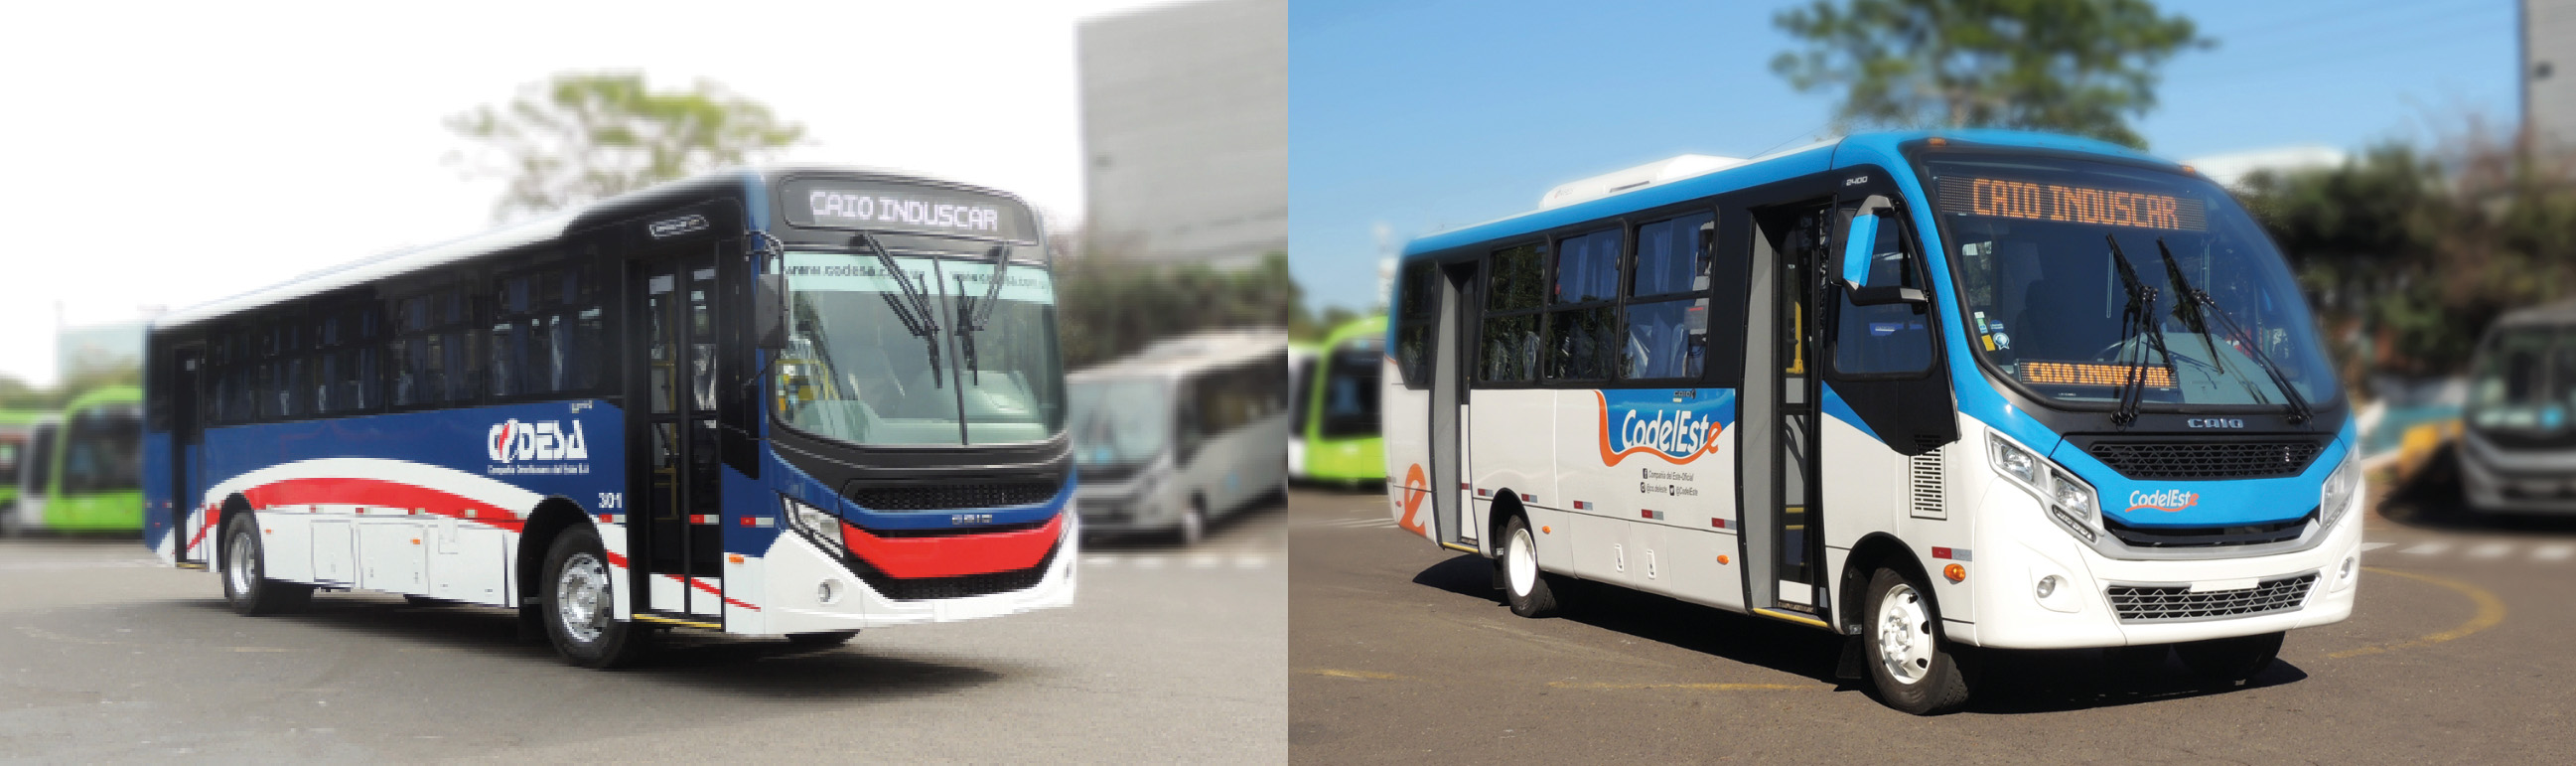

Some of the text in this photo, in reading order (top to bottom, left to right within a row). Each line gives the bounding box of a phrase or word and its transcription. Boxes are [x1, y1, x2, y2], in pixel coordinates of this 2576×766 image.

[810, 191, 998, 231] CAIO INDUSCAR
[1973, 178, 2179, 230] CAIO INDUSCAR
[2028, 362, 2075, 383] CAIO
[2188, 418, 2244, 428] CAIO
[2129, 489, 2200, 508] CodelEste
